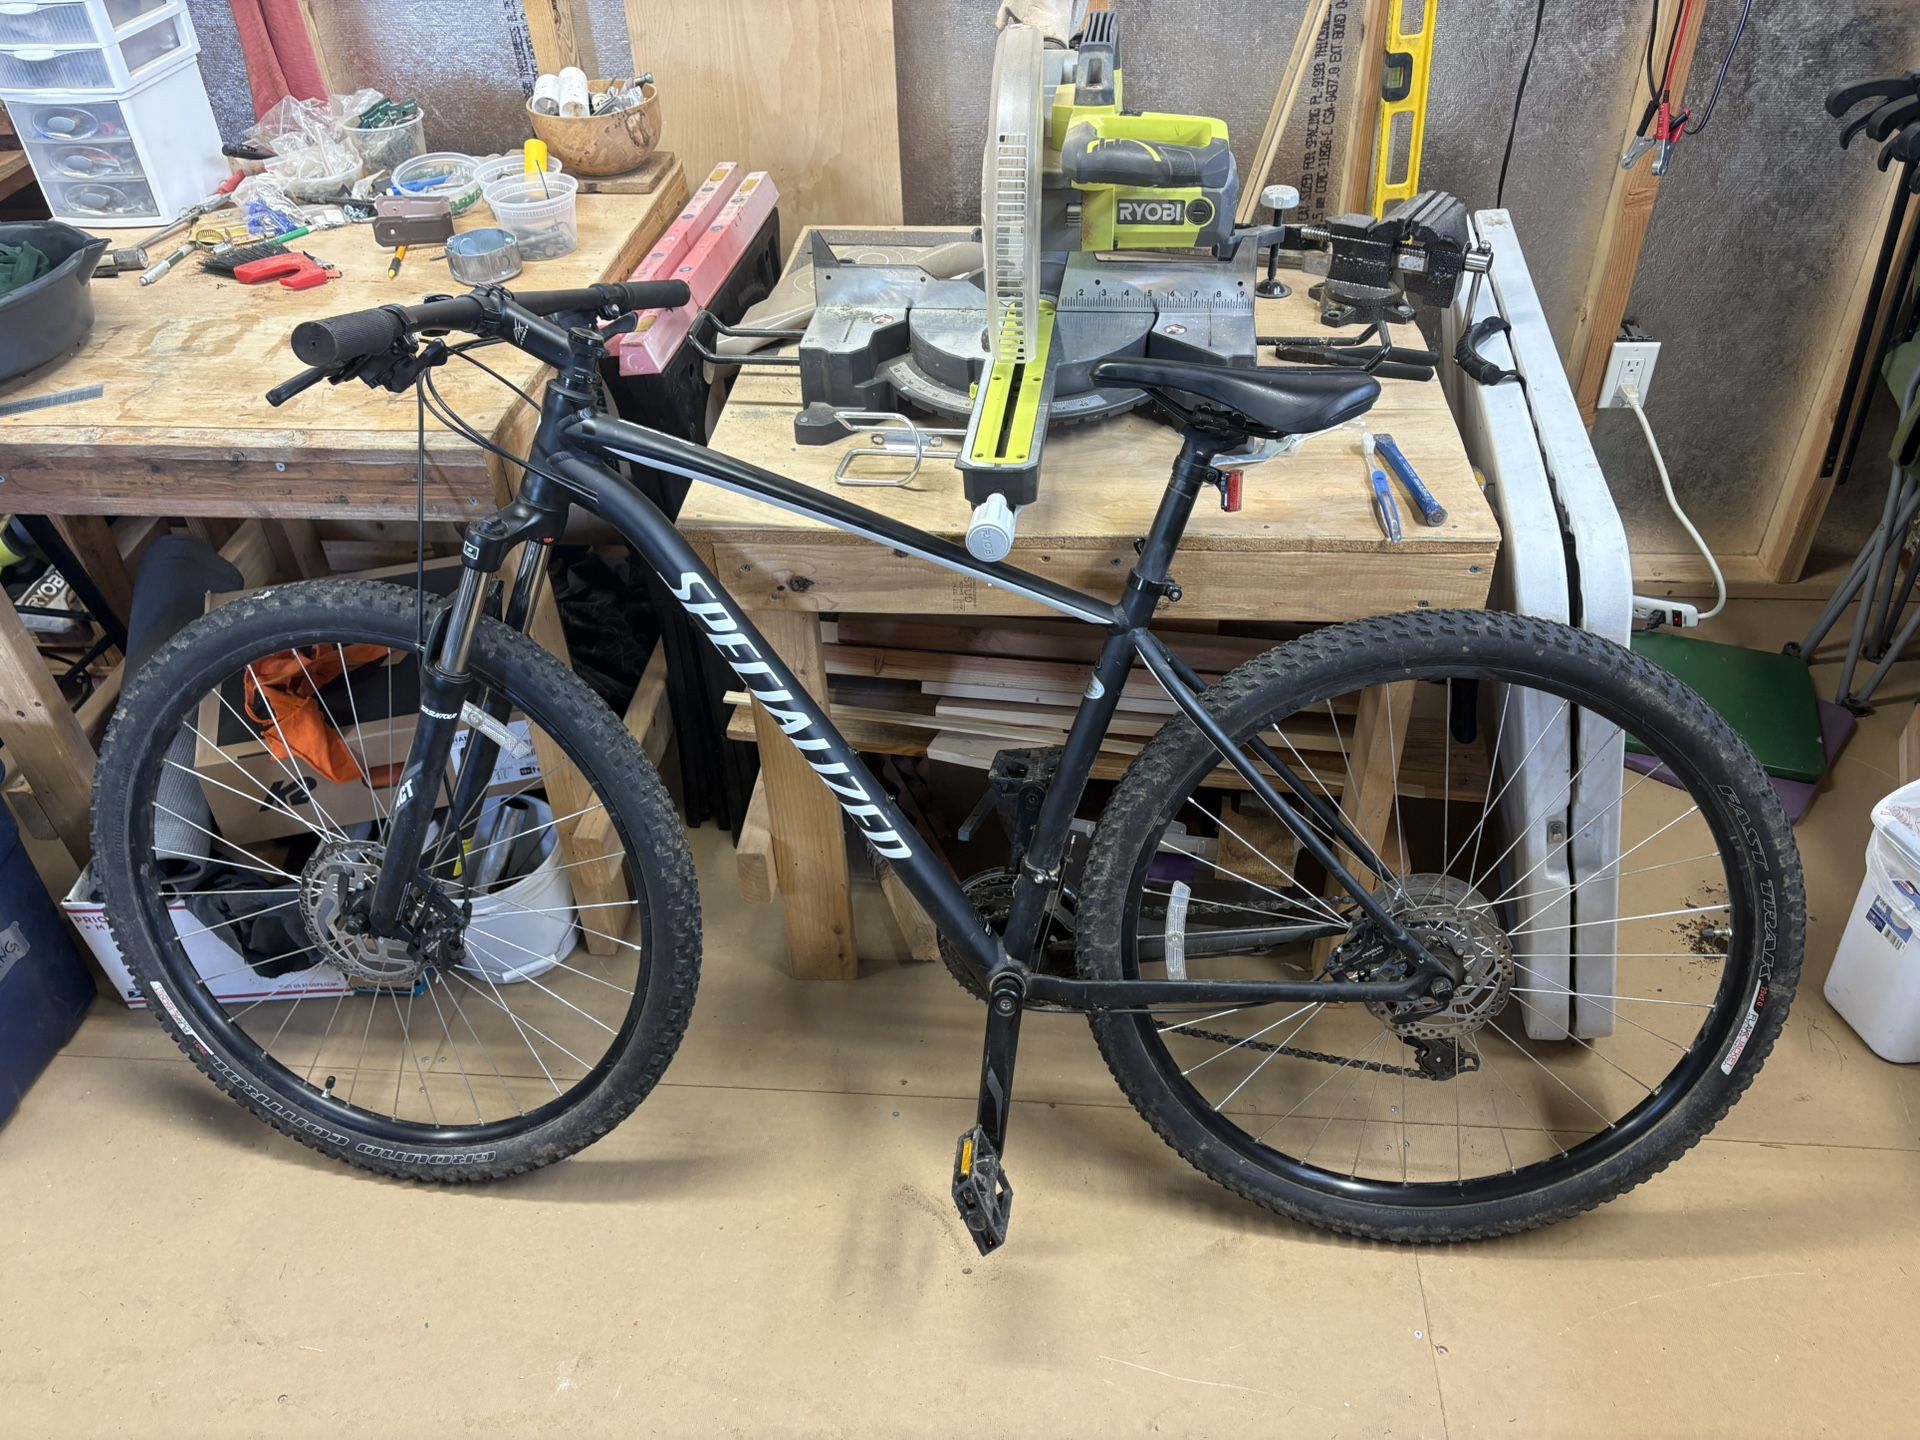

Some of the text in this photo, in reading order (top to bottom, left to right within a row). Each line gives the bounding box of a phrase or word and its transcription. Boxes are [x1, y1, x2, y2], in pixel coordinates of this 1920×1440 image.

[1332, 12, 1347, 39] BOND
[1329, 42, 1343, 63] EXT
[1304, 108, 1321, 150] SPACING
[1302, 152, 1316, 170] FOR
[1299, 173, 1314, 202] SIZED
[1119, 203, 1180, 222] RYOBI
[25, 570, 66, 607] RYOB
[964, 576, 972, 603] STUD
[660, 571, 913, 859] SPECIALIZED
[259, 776, 317, 812] K2
[1717, 784, 1776, 981] FAST TRAK
[1757, 986, 1767, 1006] 29x2.0
[1727, 1039, 1745, 1067] JACKET
[212, 1054, 496, 1166] GROUND CONTROL
